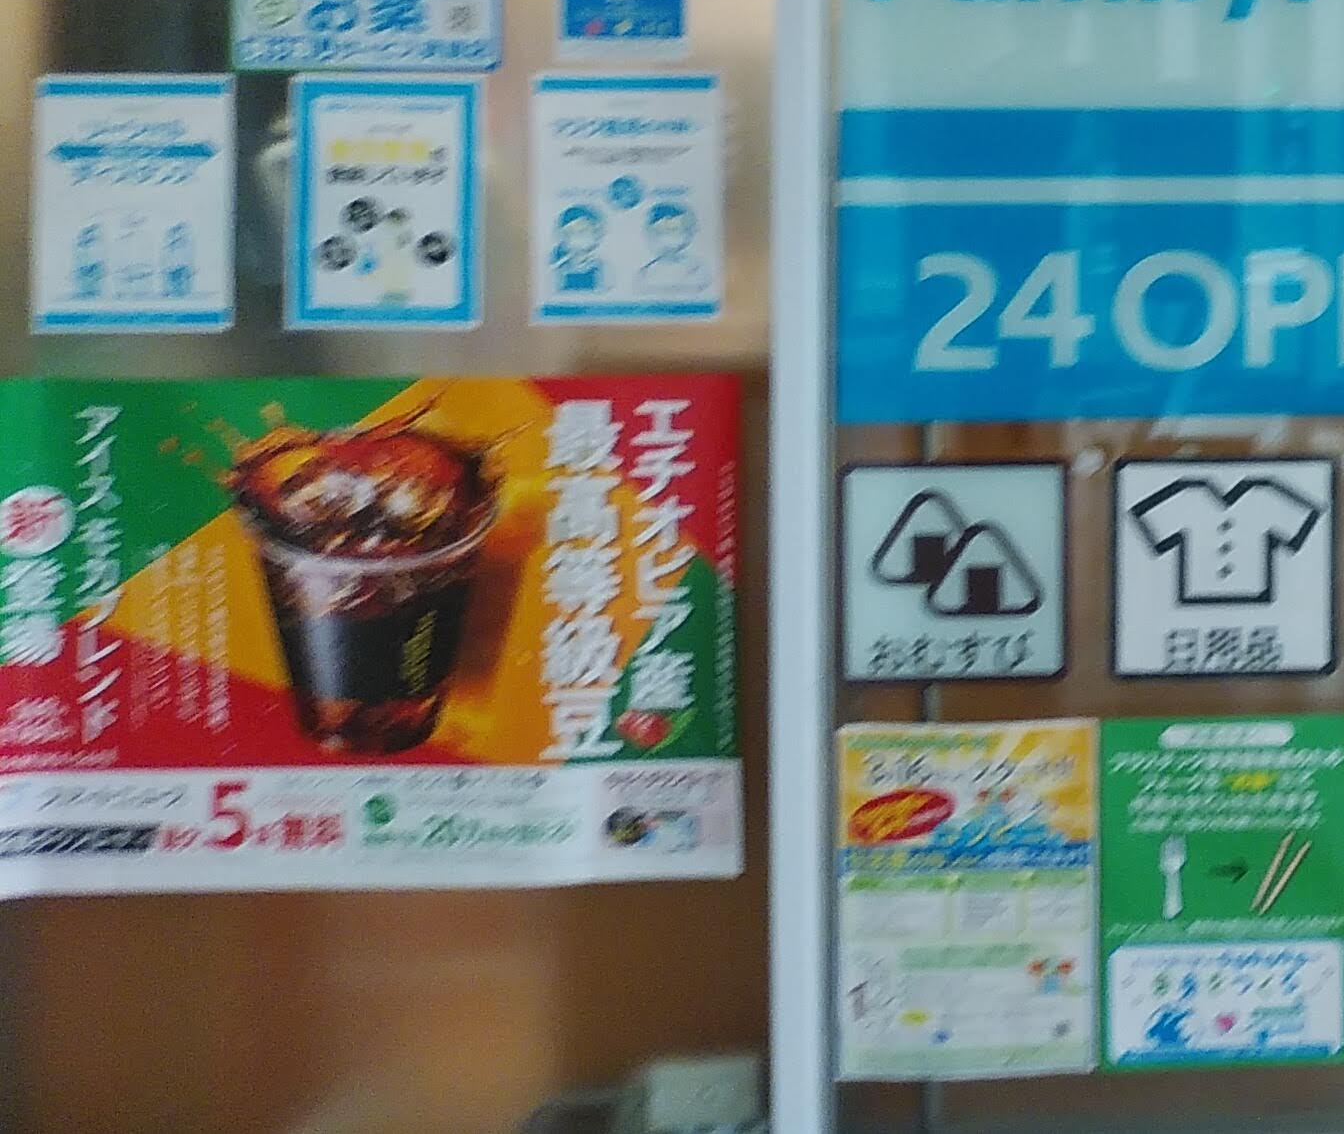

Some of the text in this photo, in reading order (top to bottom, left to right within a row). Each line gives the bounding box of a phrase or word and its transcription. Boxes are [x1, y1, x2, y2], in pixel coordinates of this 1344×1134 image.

[911, 249, 1096, 374] 24
[629, 398, 698, 712] エチオピア産
[868, 629, 1035, 676] おむすび
[1165, 626, 1284, 672] 日用品
